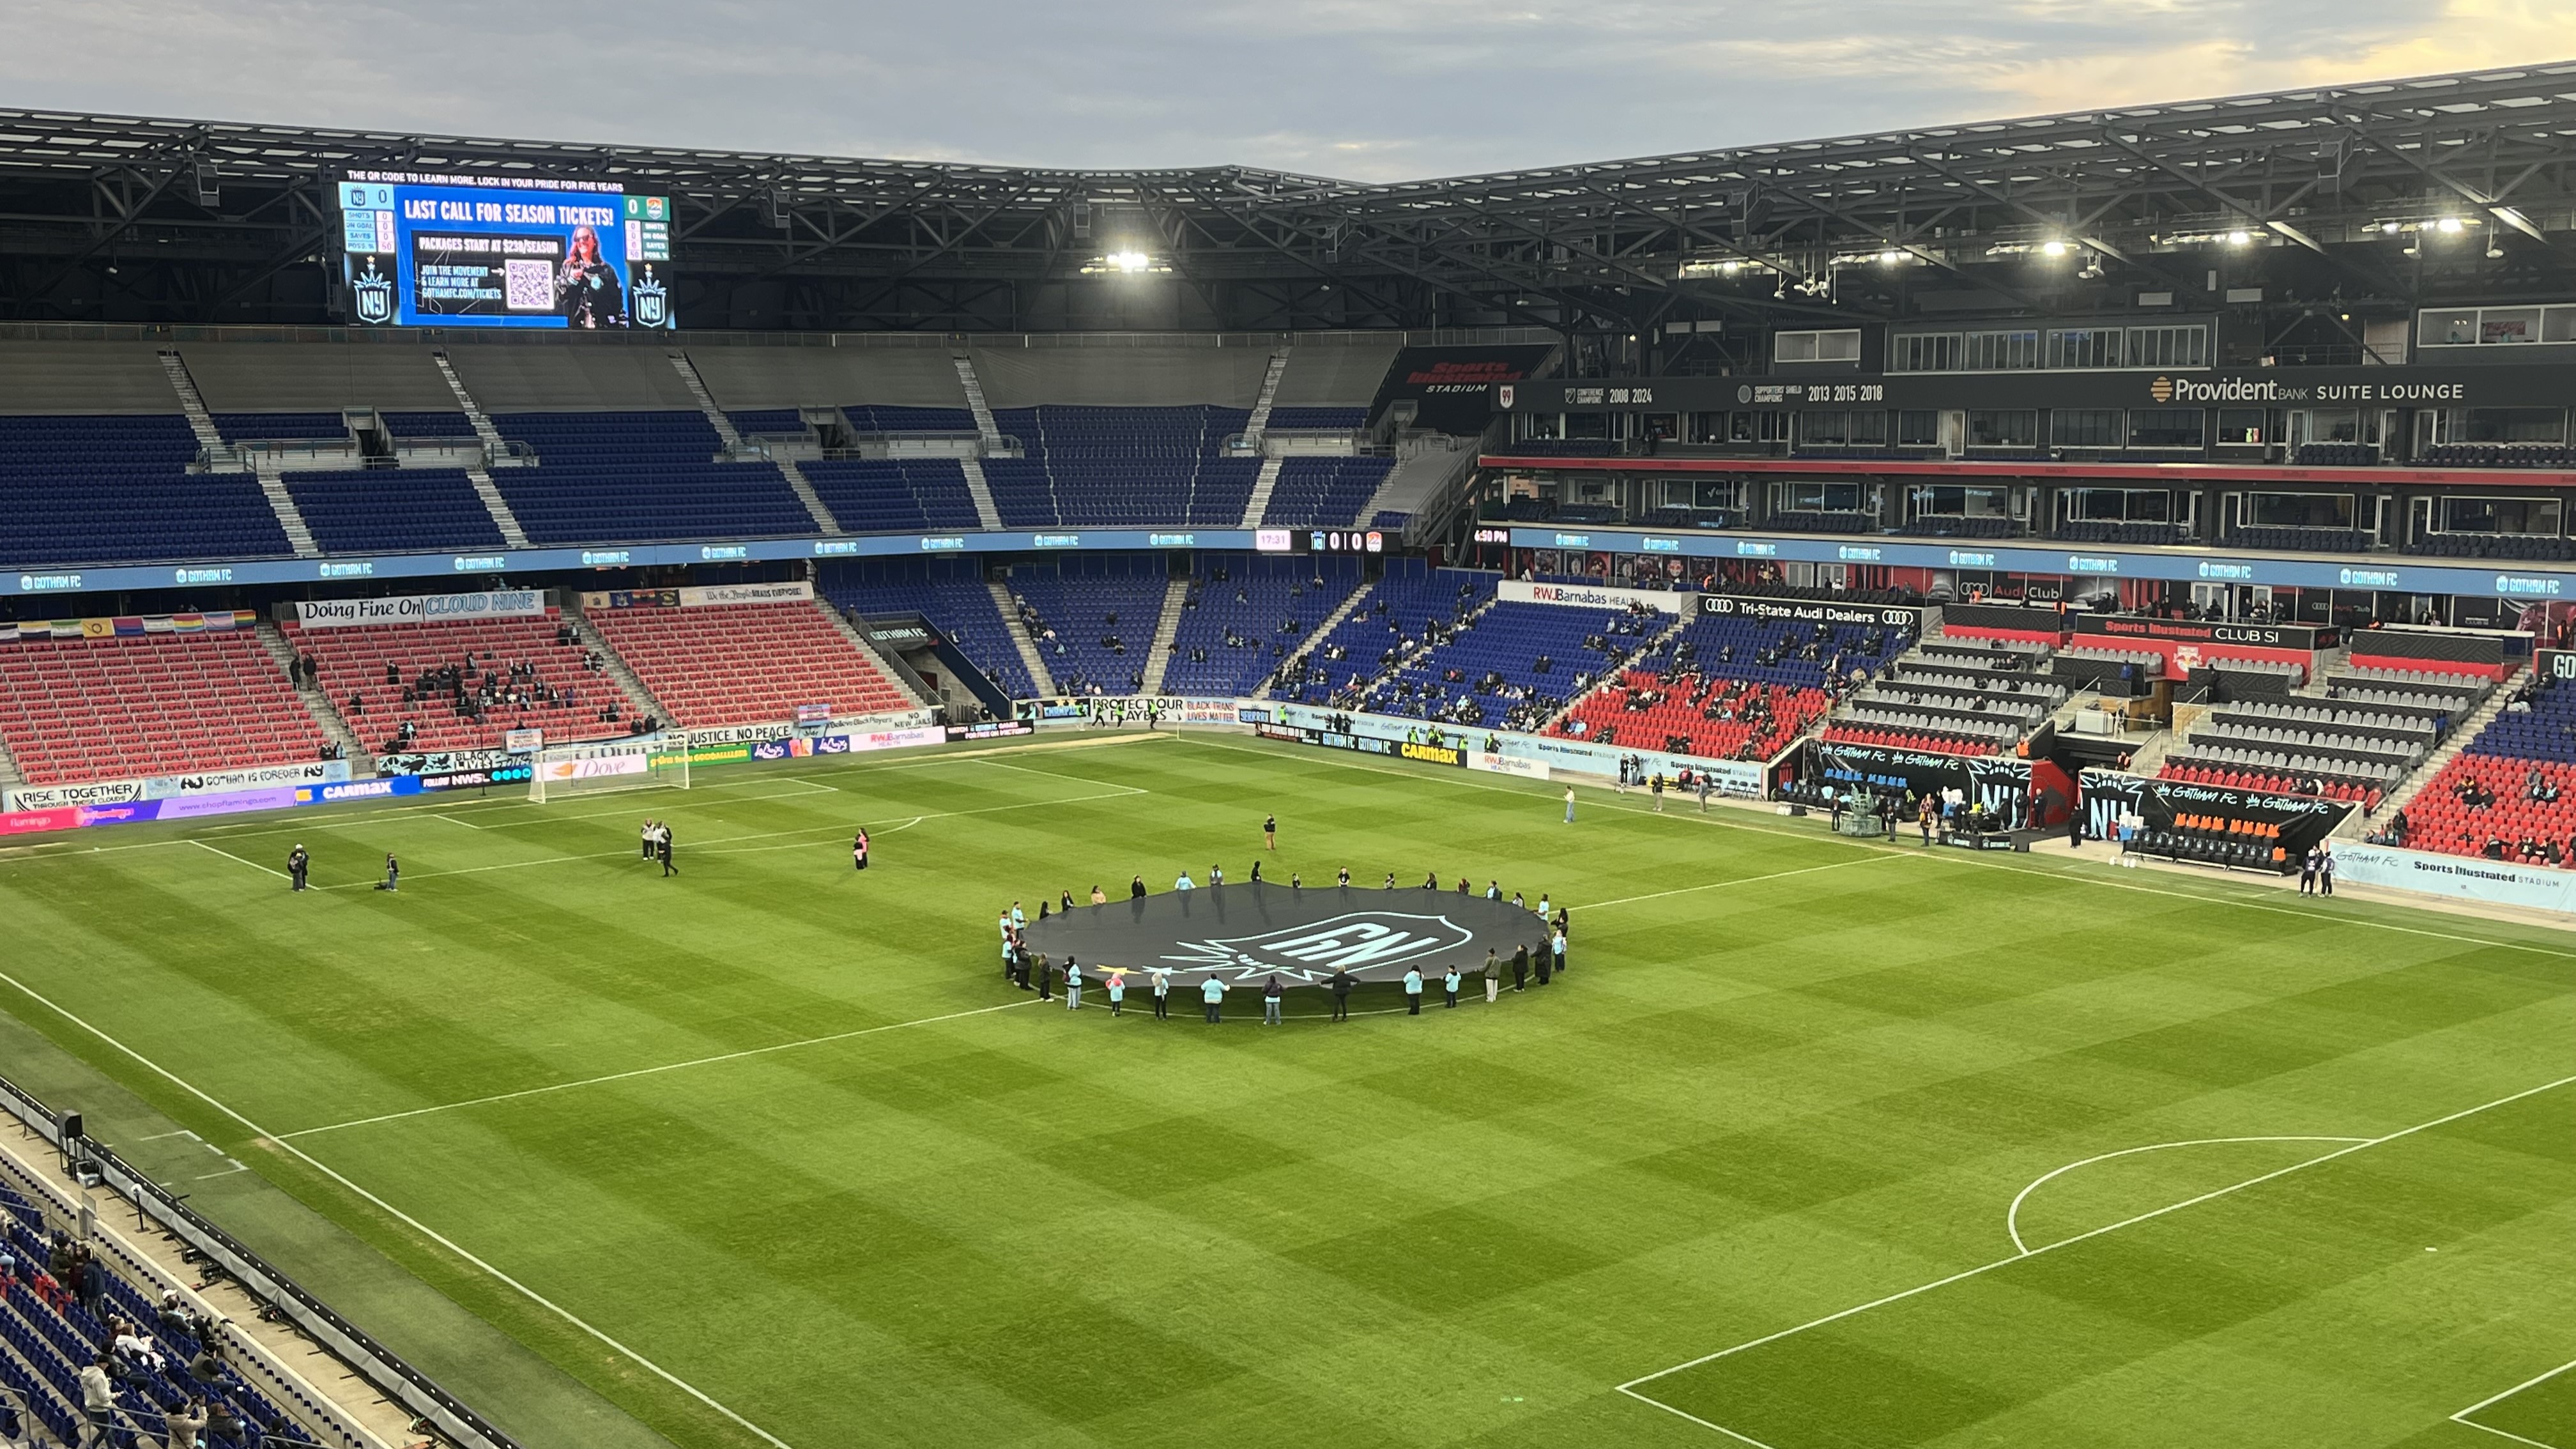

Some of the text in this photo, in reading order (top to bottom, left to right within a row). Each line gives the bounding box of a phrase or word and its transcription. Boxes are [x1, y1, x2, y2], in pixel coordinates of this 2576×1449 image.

[347, 170, 365, 180] THE
[367, 171, 379, 181] QR
[381, 172, 405, 181] CODE
[406, 173, 418, 182] TO
[419, 174, 448, 183] LEARN
[477, 177, 500, 186] LOCK
[501, 178, 510, 186] IN
[512, 178, 534, 187] YOUR
[535, 179, 559, 189] PRIDE
[561, 180, 578, 190] FOR
[579, 181, 596, 190] FIVE
[597, 182, 624, 192] YEARS
[379, 190, 387, 203] 0
[404, 199, 614, 226] LAST CALL FOR SEASON TICKETS!
[629, 199, 638, 214] 0
[419, 237, 502, 252] PACKAGES START AT
[421, 264, 488, 277] JOIN THE MOVEMENT
[428, 277, 449, 287] LEARN
[451, 277, 470, 288] MORE
[470, 278, 479, 288] AT
[422, 288, 502, 300] GOTHAMFC.COM/TICKETS
[362, 291, 385, 316] NY
[640, 296, 660, 319] NY
[1425, 385, 1488, 393] STADIUM
[1502, 389, 1511, 402] 99
[1577, 388, 1652, 403] CONFERENCE 2008 2024
[1786, 385, 1802, 394] SHIELD
[1808, 385, 1830, 402] 2013
[1834, 385, 1856, 401] 2015
[1860, 385, 1883, 401] 2018
[2175, 377, 2464, 401] Provident BANK SUITE LOUNGE
[1754, 394, 1782, 402] CHAMPIONS
[1261, 535, 1285, 544] 17:31
[1330, 532, 1340, 550] 0
[1352, 532, 1361, 550] 0
[1474, 530, 1507, 542] 6:50 PM
[465, 557, 504, 569] GOTHAM FC
[592, 551, 629, 563] GOTHAM FC
[188, 569, 232, 582] GOTHAM FC
[331, 563, 372, 576] GOTHAM FC
[2210, 564, 2251, 578] GOTHAM FC
[34, 575, 81, 588] GOTHAM FC
[2352, 571, 2398, 586] GOTHAM FC
[1993, 585, 2059, 599] Audi Club
[2509, 578, 2559, 594] GOTHAM FC
[305, 593, 535, 620] Doing Fine On CLOUD NINE
[1740, 602, 1875, 623] Tri-State Audi Dealers
[870, 627, 928, 640] GOTHAM FC
[2105, 621, 2279, 643] Sports Illustrated CLUB SI
[1156, 698, 1183, 710] OUR
[1187, 701, 1234, 711] BLACK TRANS
[870, 717, 893, 726] Players
[1187, 712, 1208, 721] LIVES
[1209, 712, 1234, 722] MATTER
[668, 735, 685, 746] NO
[737, 728, 753, 740] NO
[1322, 733, 1347, 747] GOTHAM
[1347, 735, 1355, 749] FC
[1358, 737, 1392, 754] GOTHAM FC
[1538, 744, 1558, 753] Sports
[455, 752, 490, 760] BLACK
[1871, 751, 1886, 762] FC
[455, 761, 491, 770] LIVES
[583, 760, 625, 778] Dove
[1671, 762, 1694, 770] Sports
[1695, 763, 1731, 774] Illustrated
[1944, 758, 1959, 770] FC
[206, 768, 300, 786] GOTHAM IS FOREVER
[423, 773, 490, 788] FOLLOW NWSL
[22, 784, 132, 803] RISE TOGETHER
[2220, 792, 2237, 804] FC
[33, 801, 68, 809] THROUGH
[2310, 803, 2328, 815] FC
[10, 816, 51, 827] flamingo
[2382, 856, 2399, 866] FC
[2414, 861, 2559, 887] Sports Illustrated STADIUM
